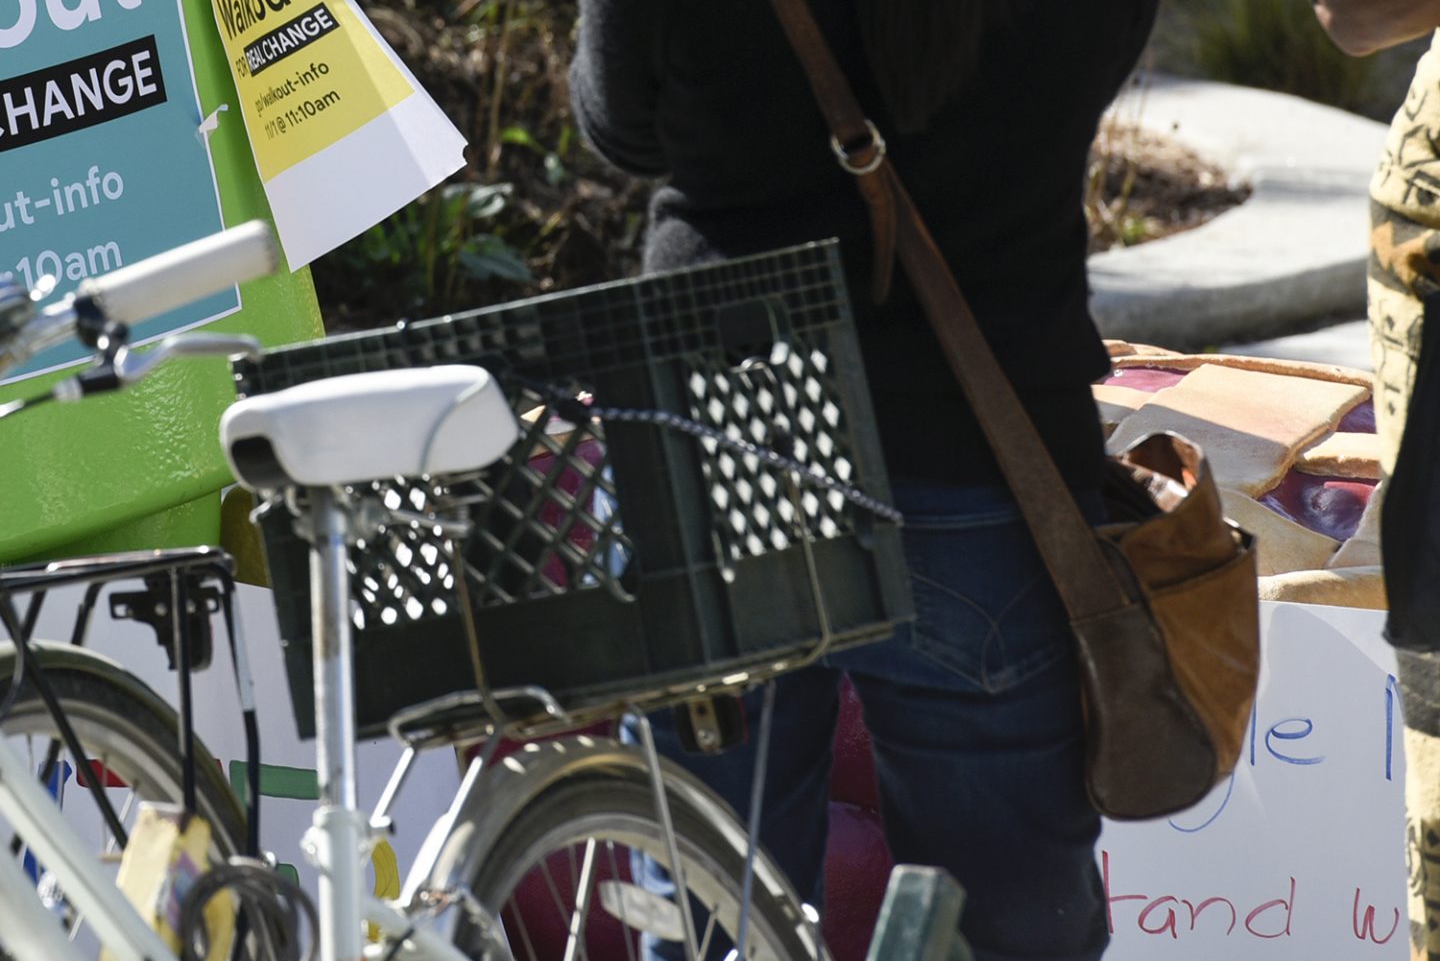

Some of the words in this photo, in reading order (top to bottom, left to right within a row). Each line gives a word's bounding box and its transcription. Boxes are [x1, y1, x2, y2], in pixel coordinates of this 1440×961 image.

[235, 56, 248, 79] FOR
[246, 47, 266, 71] REAL
[261, 9, 333, 60] CHANGE
[285, 90, 340, 126] 11:10am
